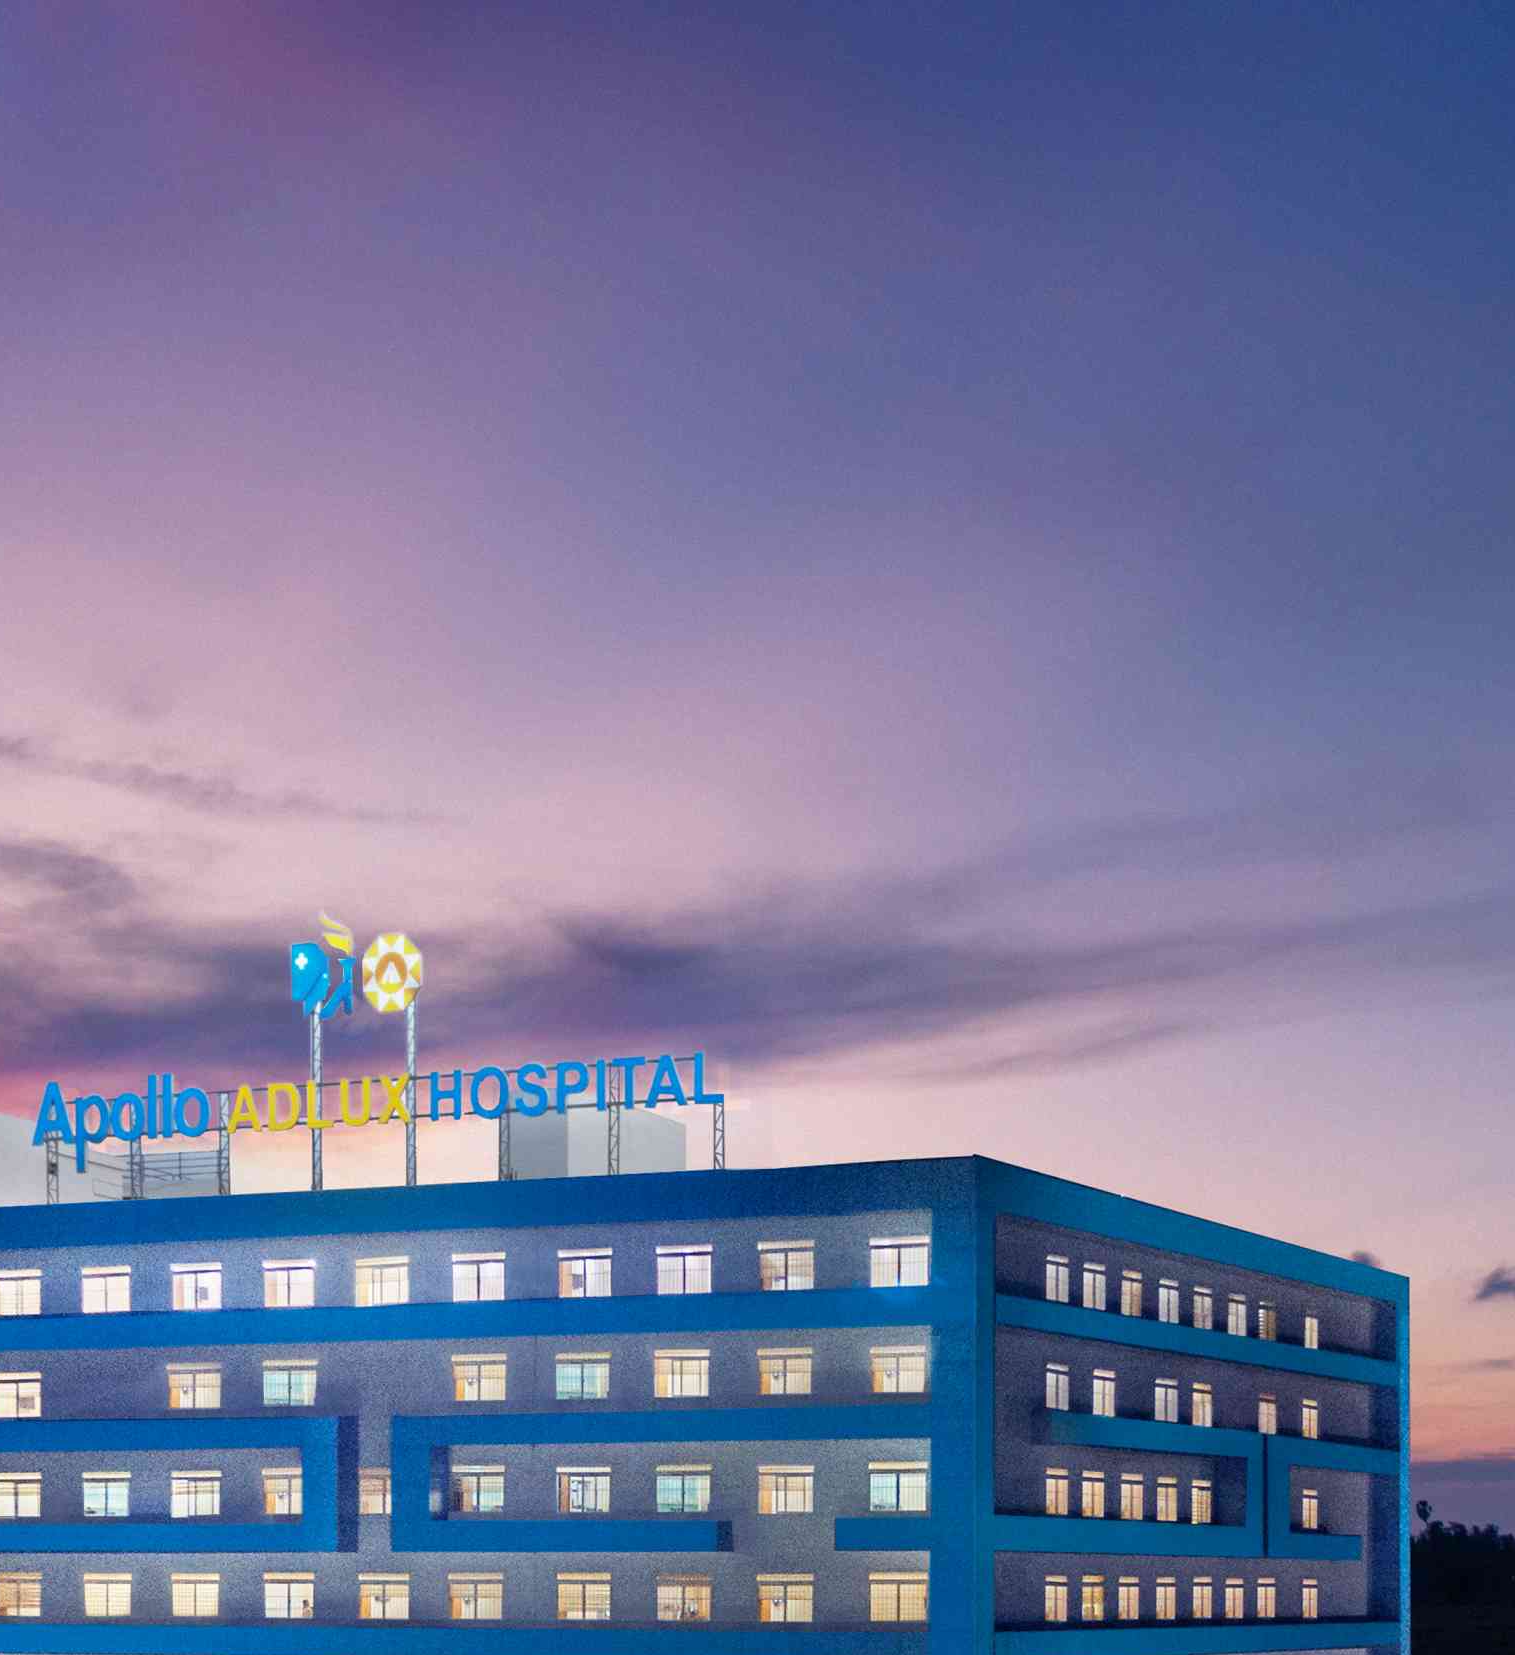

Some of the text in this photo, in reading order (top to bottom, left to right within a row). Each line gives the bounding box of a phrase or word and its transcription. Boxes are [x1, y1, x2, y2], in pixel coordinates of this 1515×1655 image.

[32, 1051, 724, 1174] Apollo ADLUX HOSPITAL
